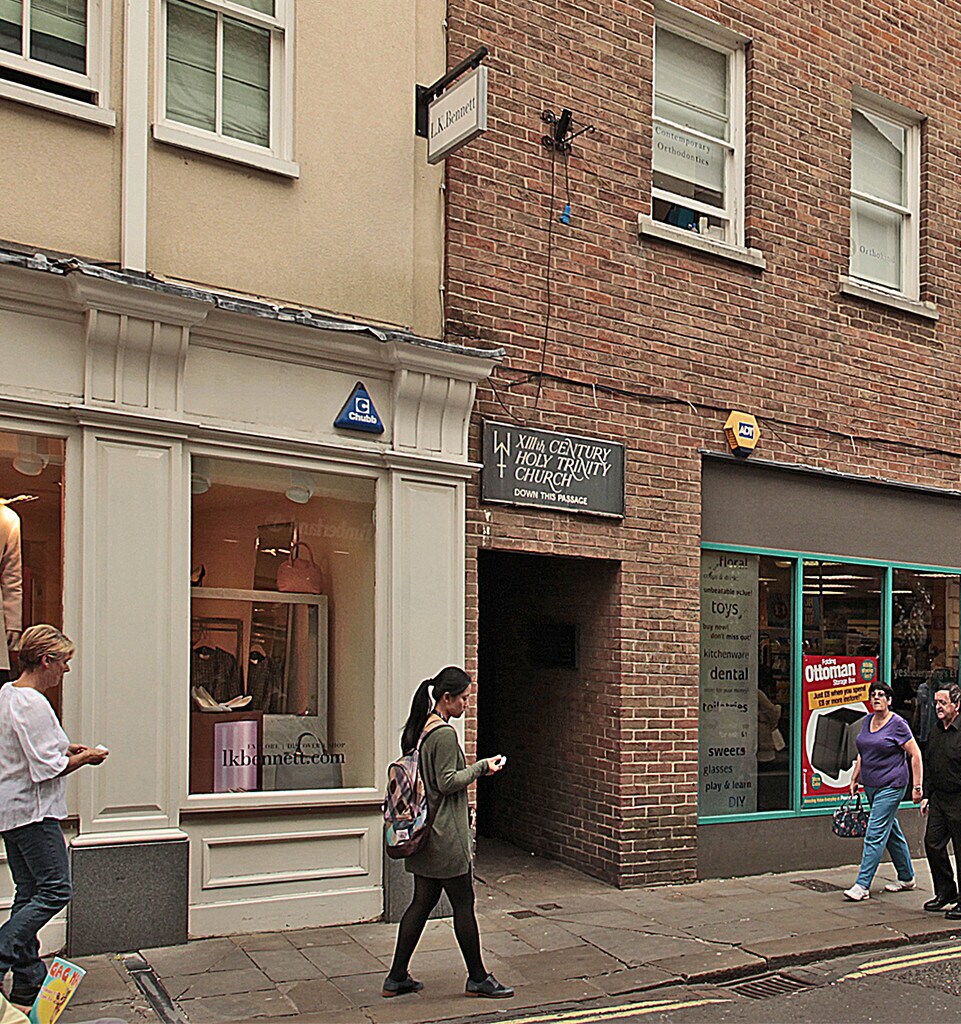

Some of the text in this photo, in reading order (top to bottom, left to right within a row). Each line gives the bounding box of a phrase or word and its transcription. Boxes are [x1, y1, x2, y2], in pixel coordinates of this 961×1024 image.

[655, 125, 711, 154] Contemporary
[657, 142, 710, 166] Orthodontics
[348, 411, 377, 424] Chubb
[739, 425, 754, 437] ADT
[549, 437, 612, 462] CENTURY
[515, 450, 612, 481] HOLY TRINITY
[514, 467, 573, 494] CHURCH
[514, 488, 588, 506] DOWN THIS PASSAGE
[719, 556, 748, 568] floral
[711, 600, 743, 619] toys,
[703, 648, 750, 660] kitchenware
[710, 667, 749, 680] dental
[805, 662, 856, 683] Ottoman
[222, 749, 345, 767] lkbennett.com
[708, 746, 746, 757] sweets
[703, 765, 734, 776] glasses
[705, 780, 752, 792] play & learn
[728, 796, 746, 808] DIY
[49, 962, 72, 983] GAG
